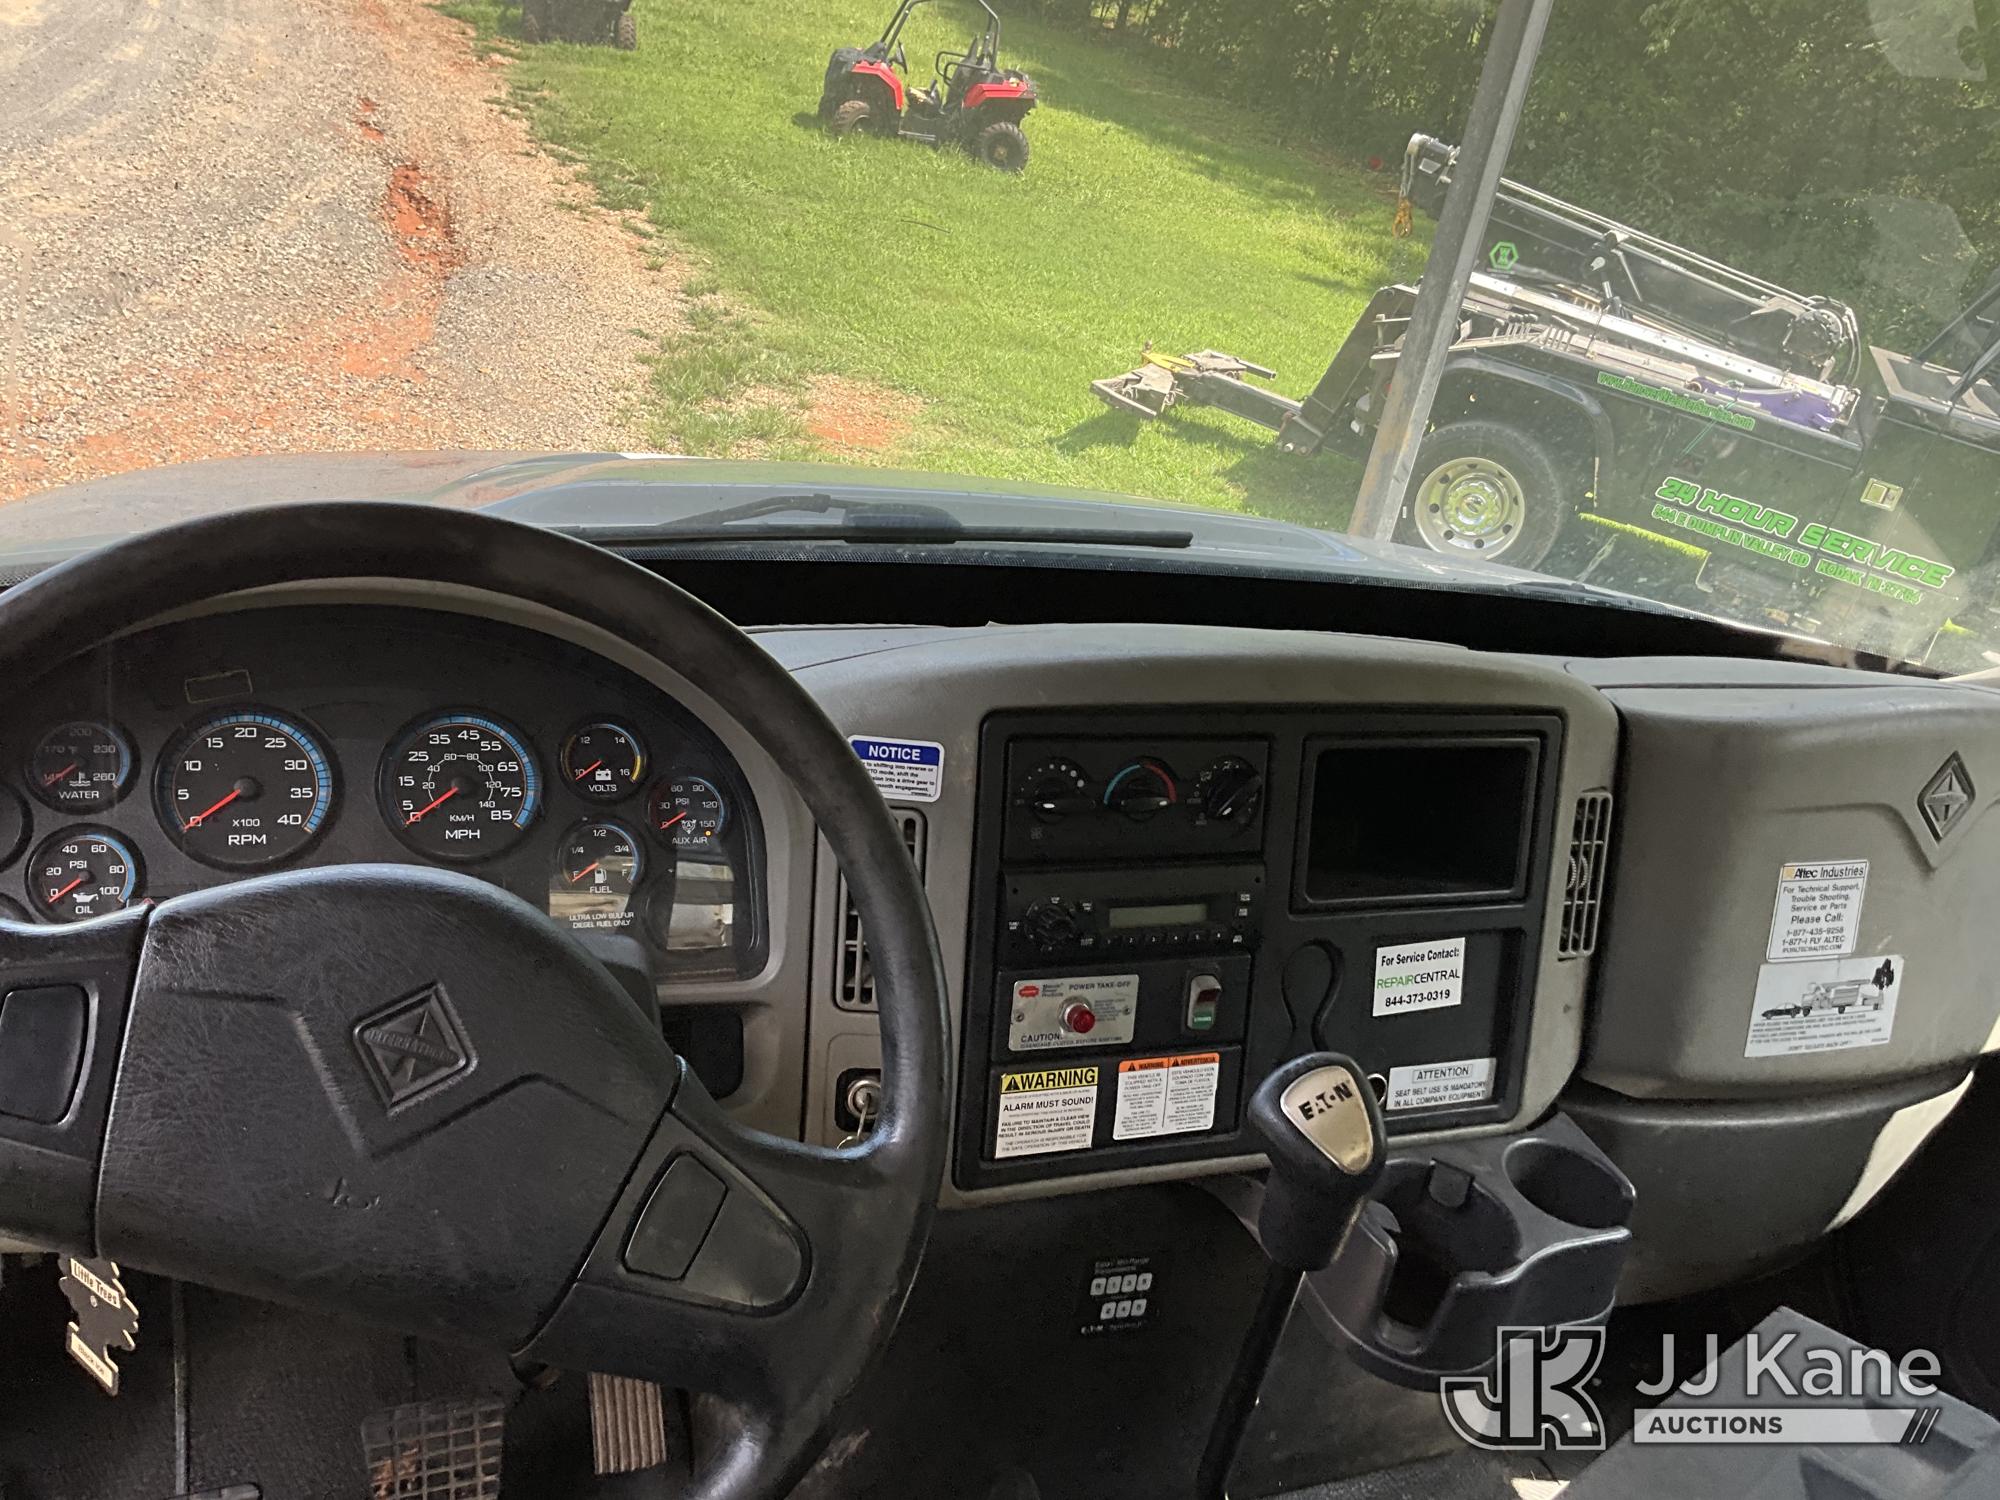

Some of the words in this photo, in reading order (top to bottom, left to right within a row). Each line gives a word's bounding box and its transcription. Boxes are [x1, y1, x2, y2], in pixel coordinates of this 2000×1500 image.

[1655, 476, 1701, 506] 24
[1696, 488, 1798, 538] HOUR
[1798, 522, 1955, 589] SERVICE
[1676, 511, 1689, 526] E
[1685, 514, 1745, 546] DUMPLIN
[1742, 533, 1792, 561] VALLEY
[1788, 549, 1811, 567] RD
[1815, 558, 1866, 586] KODAK
[234, 728, 257, 738] 20
[457, 730, 480, 740] 45
[206, 738, 223, 748] 15
[264, 738, 287, 748] 25
[429, 734, 451, 745] 35
[93, 745, 116, 754] 230
[480, 741, 502, 751] 55
[408, 752, 429, 762] 25
[444, 753, 457, 761] 60
[466, 753, 479, 761] 80
[868, 744, 921, 761] NOTICE
[185, 760, 201, 771] 10
[285, 760, 307, 771] 30
[497, 762, 519, 772] 65
[93, 773, 116, 781] 260
[398, 776, 415, 787] 15
[485, 781, 502, 789] 120
[588, 784, 617, 792] VOLTS
[671, 785, 683, 793] 60
[59, 791, 100, 799] WATER
[178, 789, 190, 800] 5
[290, 788, 313, 798] 35
[501, 787, 522, 798] 75
[402, 800, 414, 811] 5
[675, 798, 690, 806] PSI
[702, 801, 718, 809] 120
[277, 814, 302, 825] 40
[450, 814, 475, 822] KM/H
[490, 811, 513, 821] 85
[699, 820, 716, 828] 150
[445, 829, 480, 840] MPH
[593, 829, 607, 838] 1/2
[228, 834, 267, 846] RPM
[672, 837, 691, 845] AUX
[693, 837, 708, 845] AIR
[62, 845, 78, 853] 40
[91, 845, 107, 853] 60
[615, 845, 629, 853] 3/4
[69, 861, 87, 869] PSI
[109, 865, 125, 874] 80
[46, 867, 62, 876] 20
[622, 869, 627, 877] F
[1794, 868, 1818, 879] Altec
[1820, 866, 1864, 878] Industries
[50, 889, 59, 897] 0
[99, 887, 120, 895] 100
[589, 886, 612, 894] FUEL
[1783, 886, 1794, 894] For
[1798, 884, 1830, 893] Technical
[1791, 895, 1816, 903] Trouble
[75, 906, 93, 914] OIL
[1791, 904, 1817, 912] Service
[1829, 902, 1847, 910] Parts
[613, 919, 631, 927] ONLY
[1791, 915, 1820, 925] Please
[1809, 937, 1822, 945] FLY
[1824, 935, 1845, 944] ALTEC
[1381, 955, 1394, 967] For
[1396, 951, 1425, 965] Service
[1427, 947, 1459, 961] Contact:
[1377, 968, 1460, 989] REPAIRCENTRAL
[1069, 982, 1095, 991] POWER
[1385, 989, 1450, 1007] 844-373-0319
[1416, 1067, 1469, 1080] ATTENTION
[1020, 1068, 1096, 1090] WARNING
[1395, 1089, 1410, 1097] SEAT
[1412, 1087, 1427, 1095] BELT
[1428, 1085, 1440, 1093] USE
[1443, 1084, 1449, 1092] IS
[1450, 1081, 1487, 1090] MANDATORY
[1402, 1099, 1414, 1107] ALL
[1415, 1095, 1447, 1105] COMPANY
[1448, 1090, 1486, 1101] EQUIPMENT
[1003, 1102, 1034, 1112] ALARM
[1035, 1100, 1059, 1109] MUST
[1061, 1097, 1094, 1107] SOUND!
[96, 1280, 117, 1304] Trees
